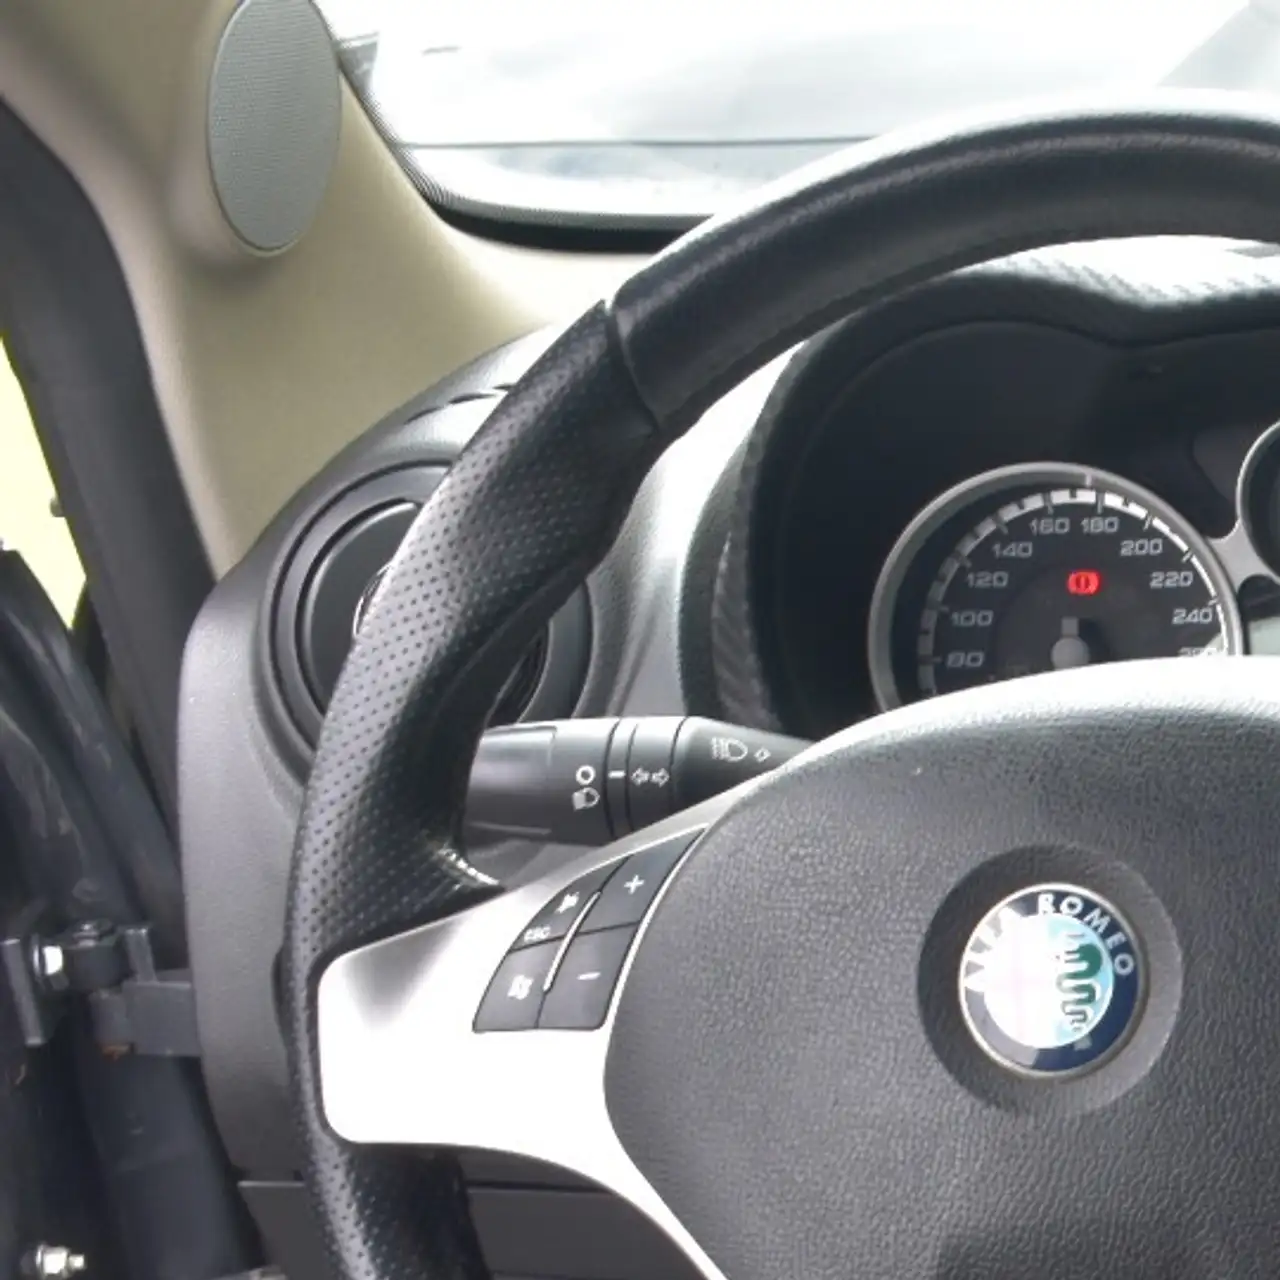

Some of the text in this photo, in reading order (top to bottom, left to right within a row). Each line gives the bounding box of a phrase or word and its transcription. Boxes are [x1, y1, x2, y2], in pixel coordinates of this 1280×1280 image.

[992, 541, 1034, 559] 140
[1120, 537, 1164, 557] 200
[965, 570, 1010, 588] 120
[1149, 570, 1194, 588] 220
[951, 610, 994, 628] 100
[1171, 607, 1214, 626] 240
[1036, 893, 1135, 976] ROMEO
